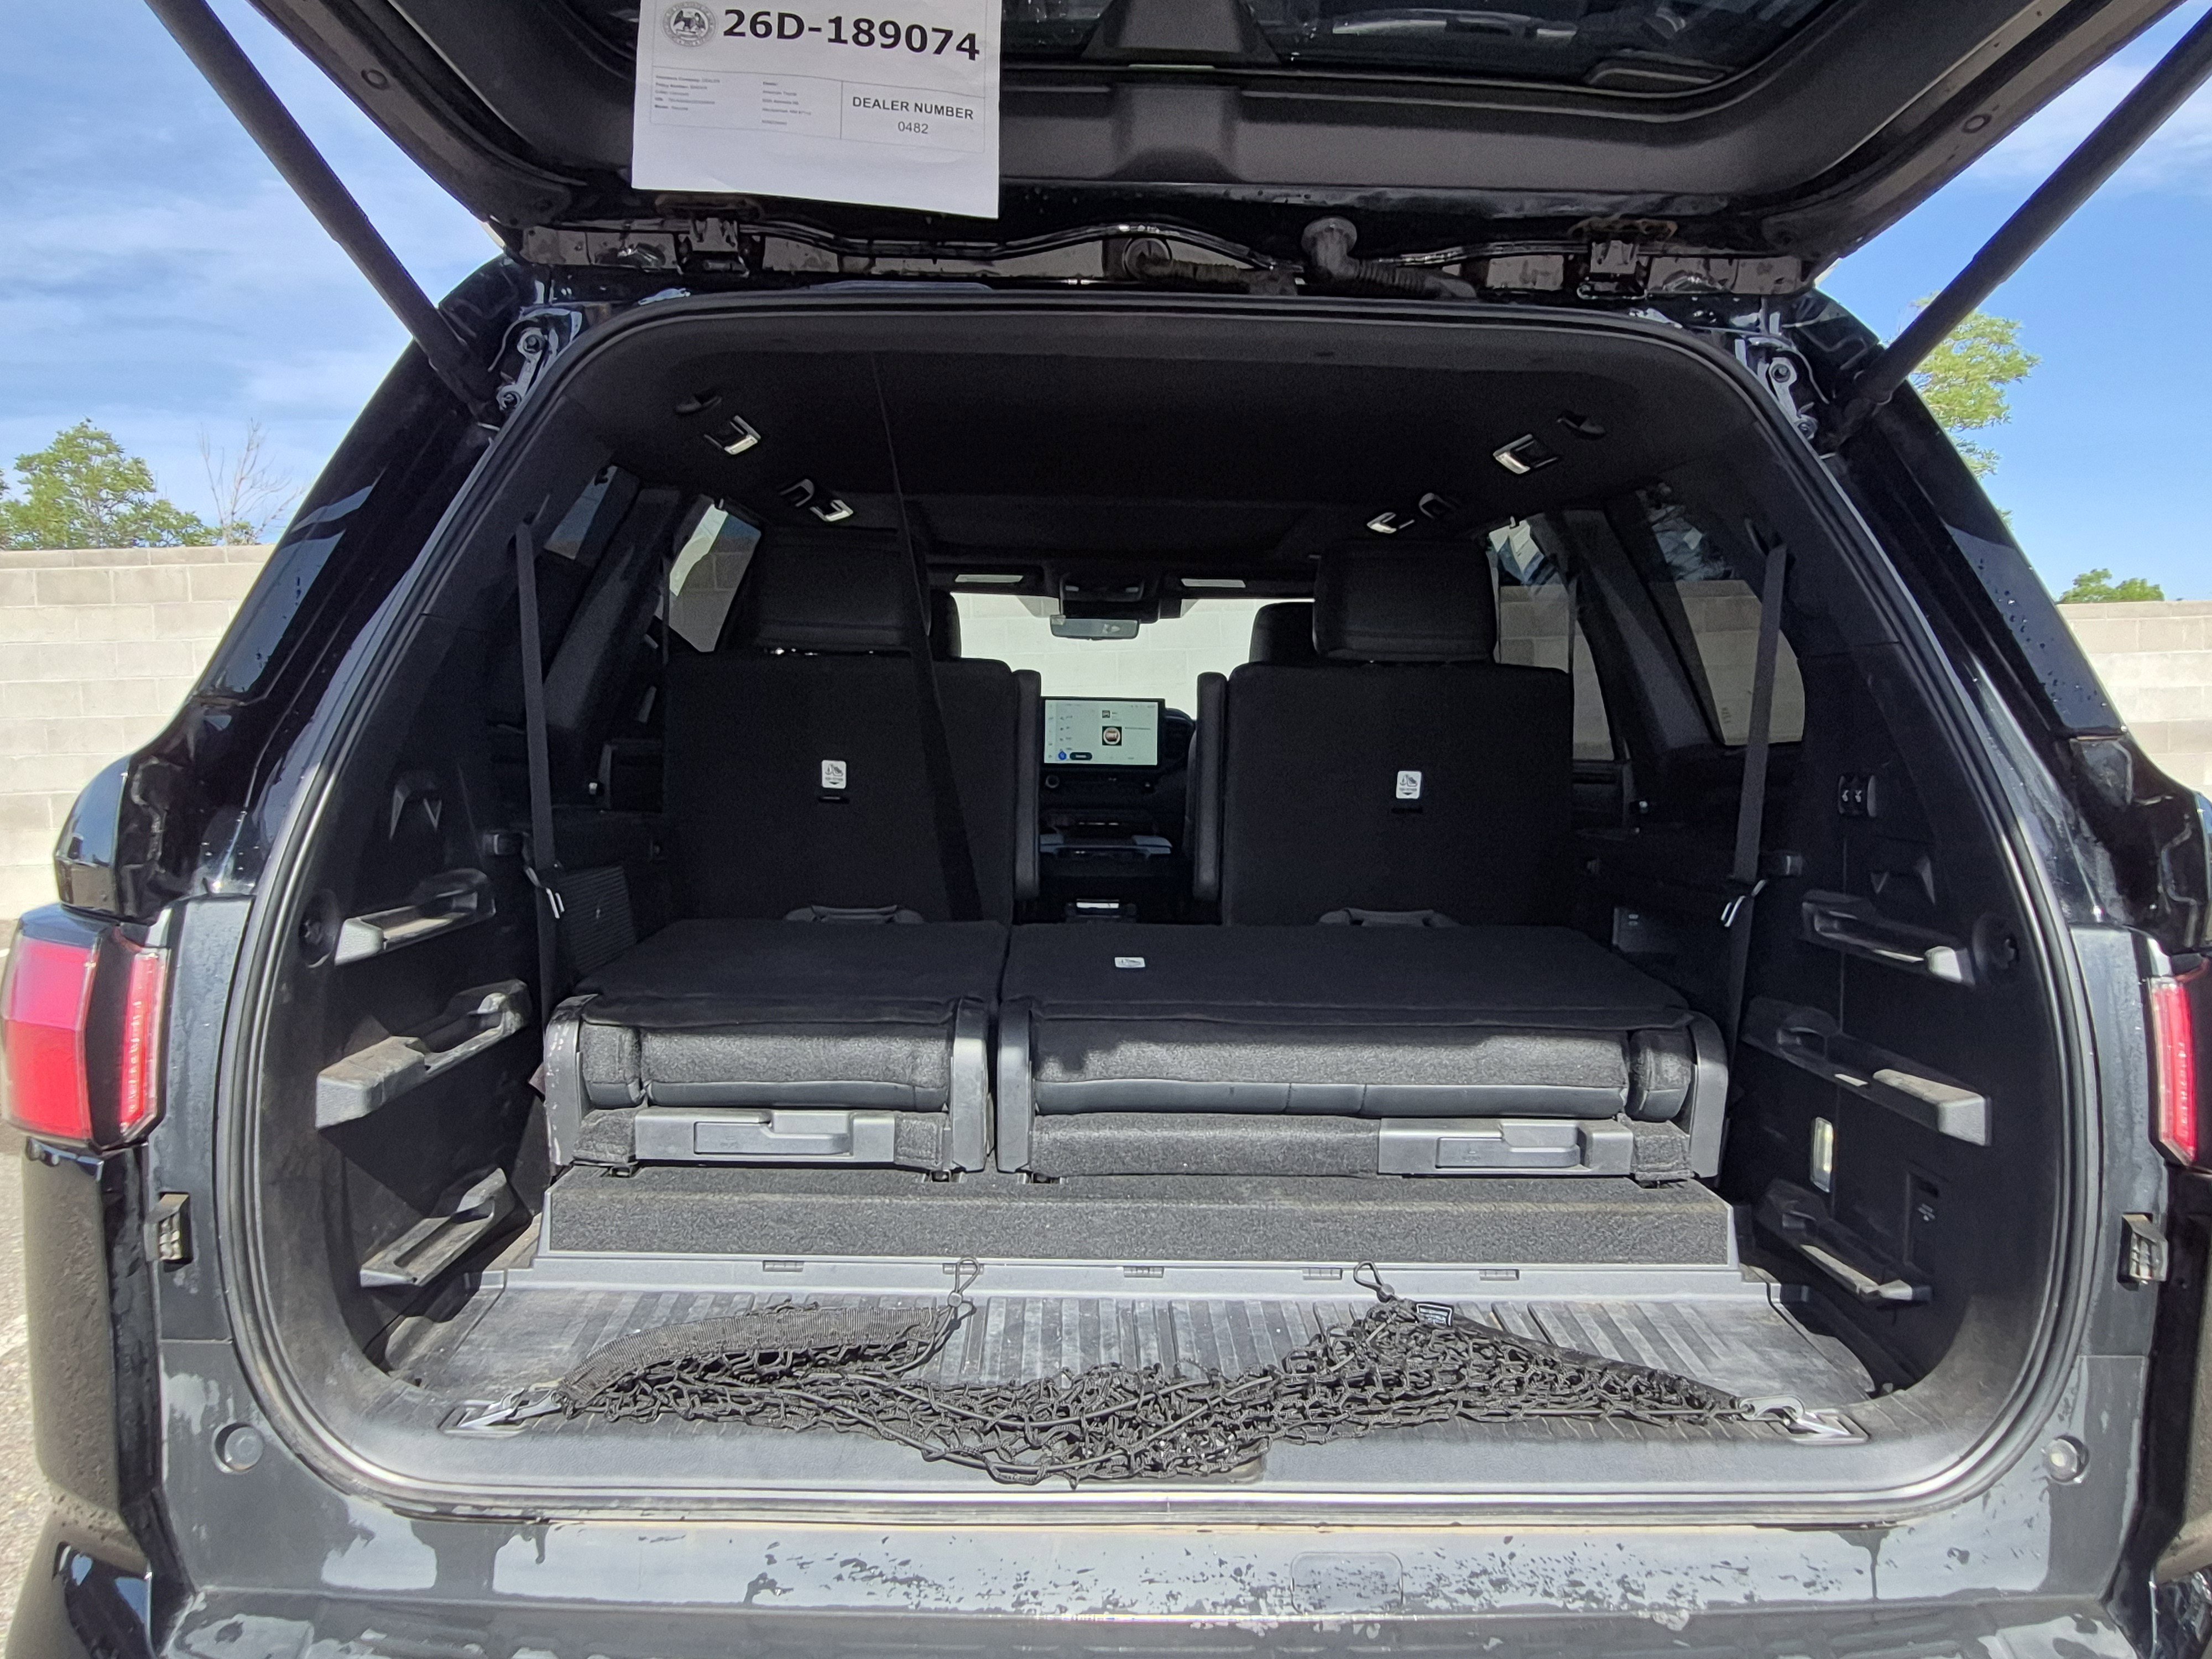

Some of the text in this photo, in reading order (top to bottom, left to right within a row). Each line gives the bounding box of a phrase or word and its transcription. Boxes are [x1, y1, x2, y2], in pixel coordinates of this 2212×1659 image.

[723, 9, 980, 61] 26D-189074
[853, 96, 973, 120] DEALER NUMBER
[898, 121, 929, 134] 0482
